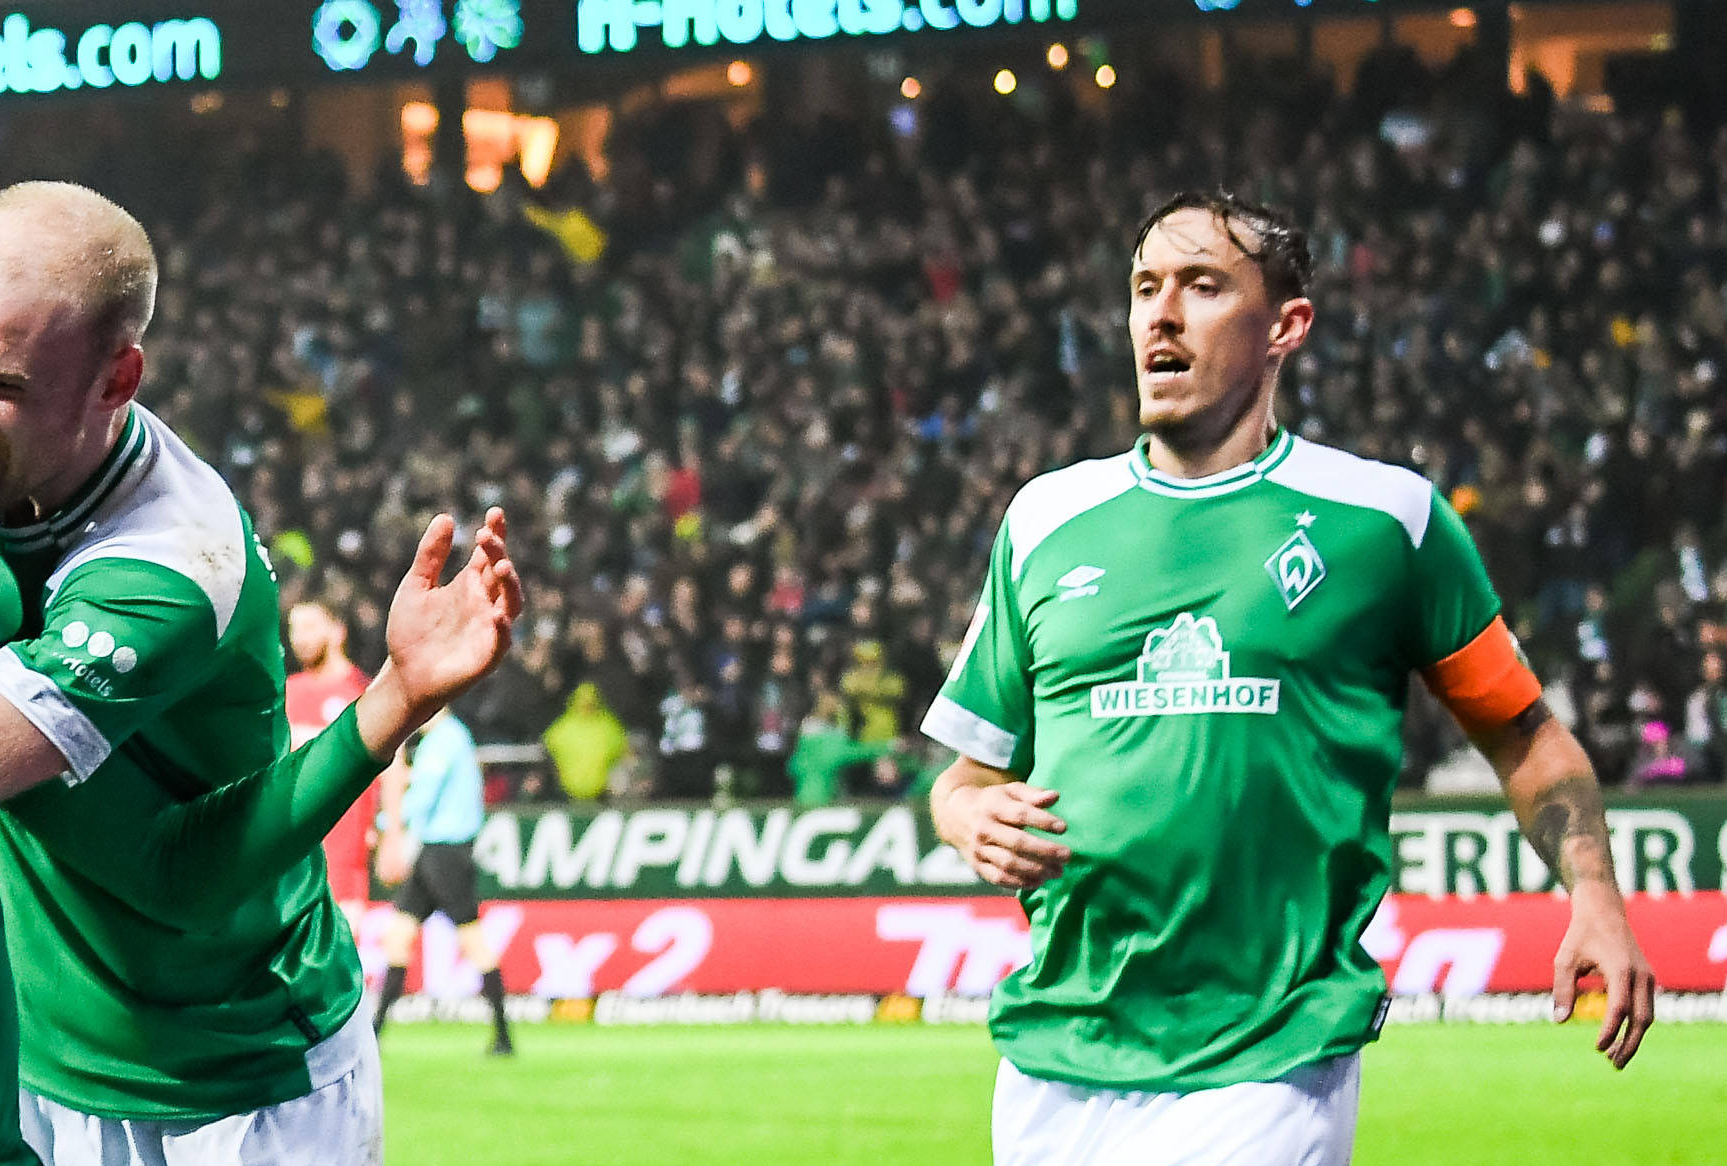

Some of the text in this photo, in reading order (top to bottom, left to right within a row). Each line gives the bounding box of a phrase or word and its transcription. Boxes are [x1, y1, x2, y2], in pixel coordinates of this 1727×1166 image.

[1098, 685, 1274, 711] WIESENHOF
[472, 806, 982, 888] AMPINGA
[530, 931, 619, 1000] x
[623, 904, 713, 1000] 2
